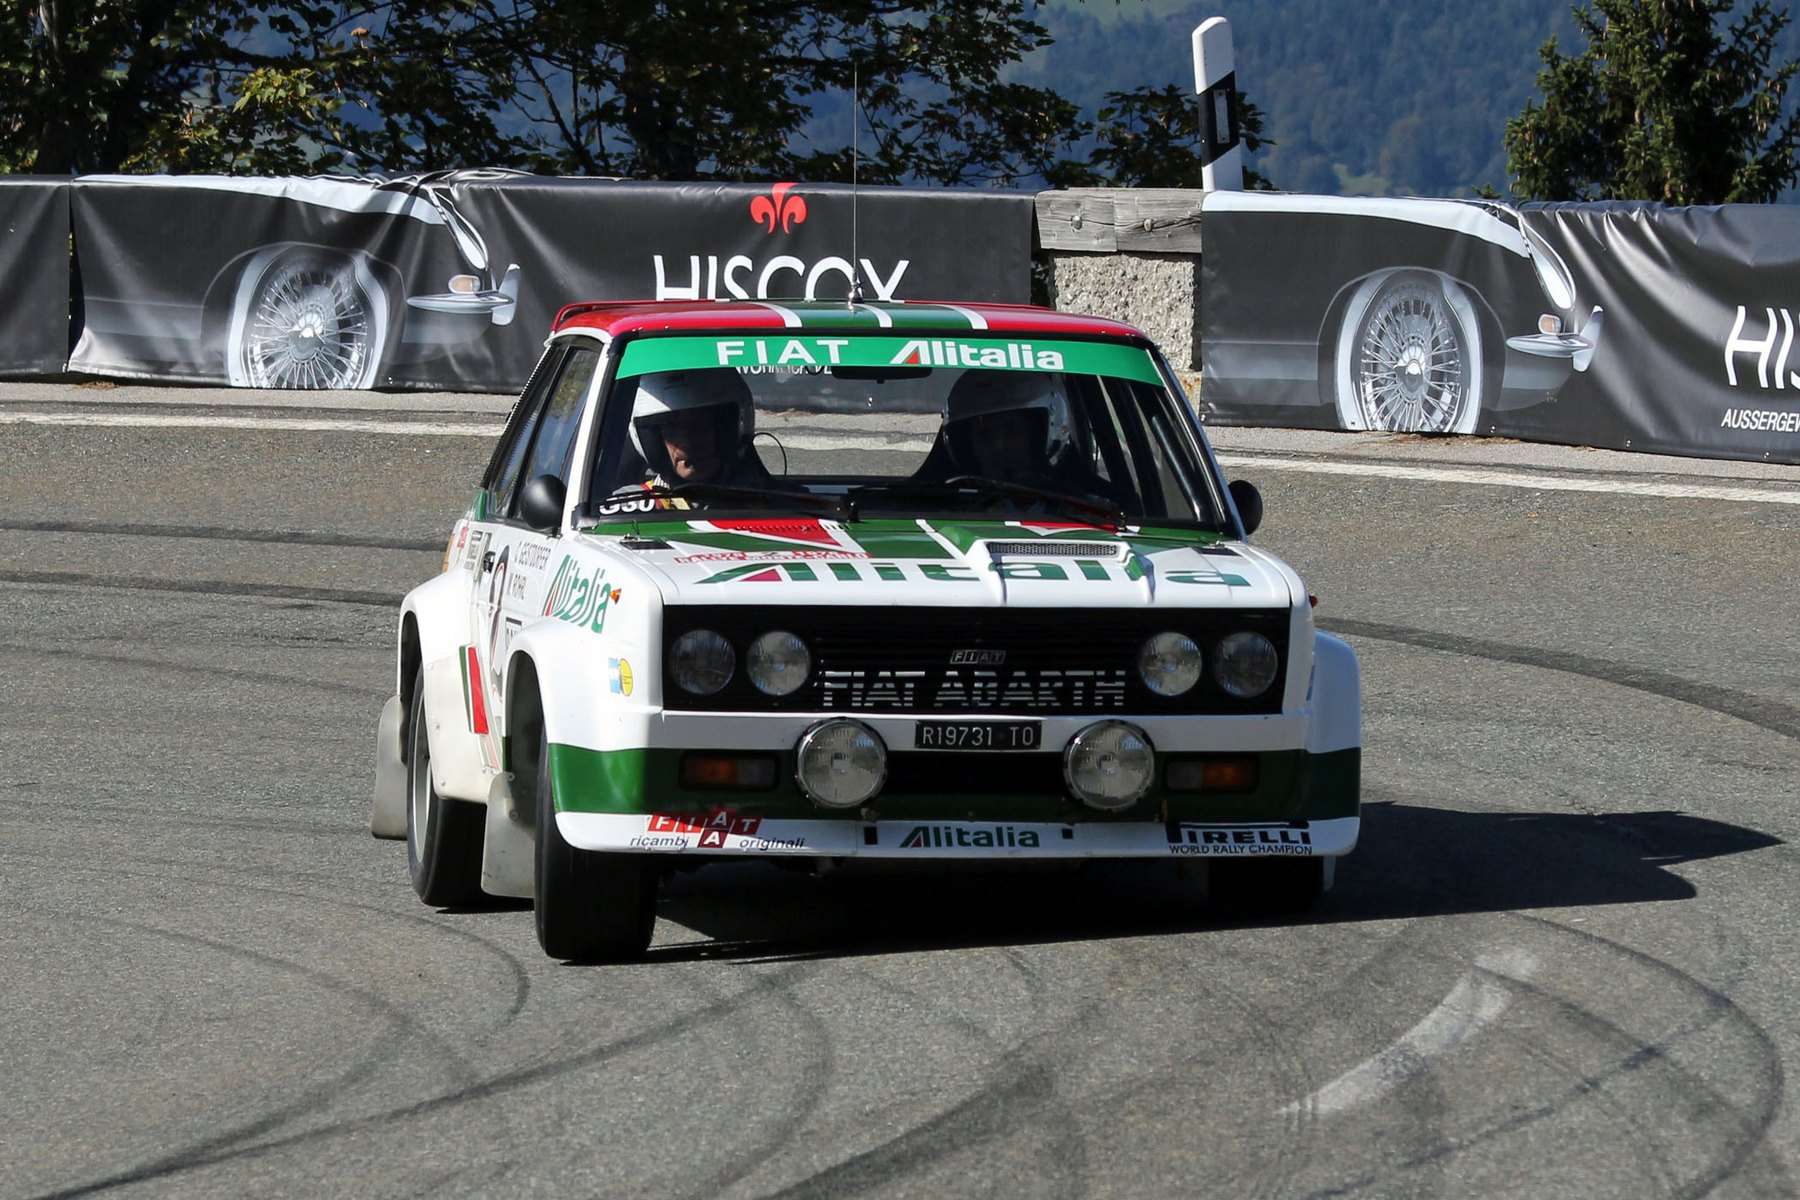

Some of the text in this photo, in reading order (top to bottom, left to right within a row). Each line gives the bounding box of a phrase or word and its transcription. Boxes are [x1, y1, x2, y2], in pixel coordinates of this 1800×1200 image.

[716, 339, 1064, 370] FIAT Alitalia
[1724, 305, 1800, 389] HI
[694, 552, 1251, 587] Alitalia
[541, 554, 612, 634] Alitalia
[953, 650, 1004, 664] FIAT
[823, 671, 1125, 706] FIAT ABARTH
[922, 726, 992, 746] R19731
[655, 811, 756, 832] FIAT
[1166, 820, 1311, 844] PIRELLI
[630, 835, 689, 848] ricambi
[739, 837, 805, 851] originali
[900, 826, 1040, 848] Alitalia
[1168, 845, 1312, 855] WORLD RALLY CHAMPION
